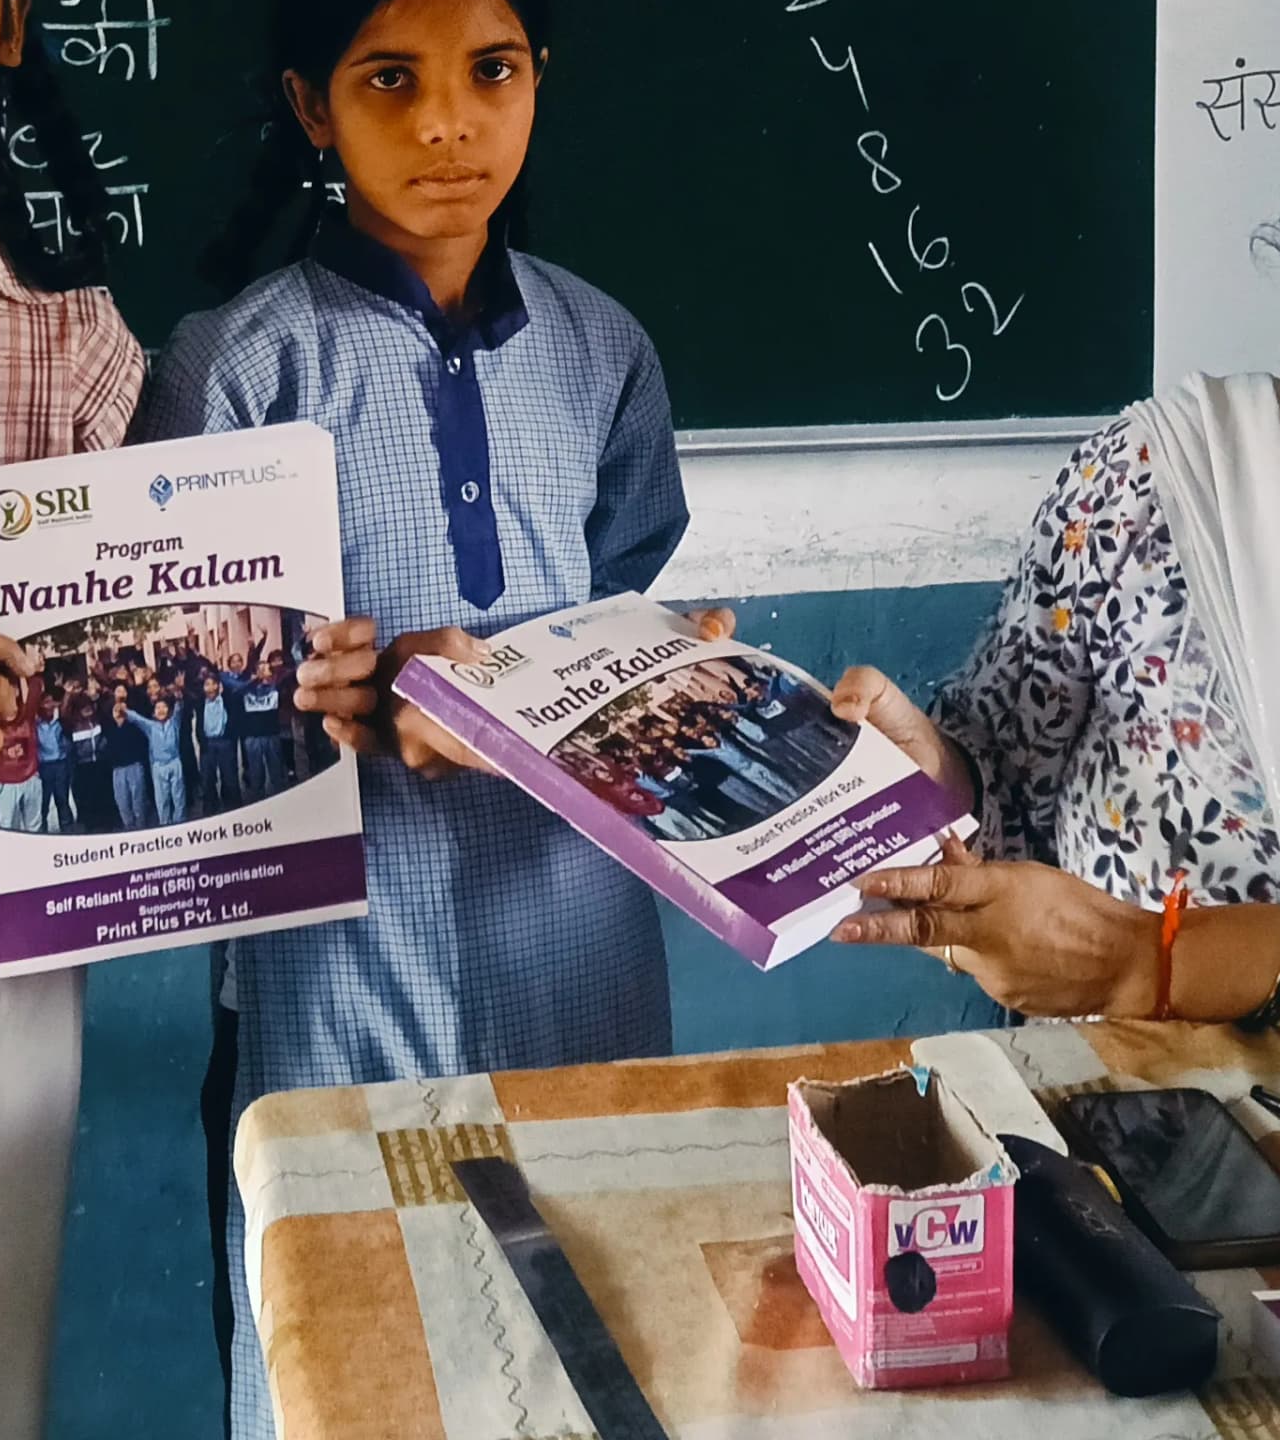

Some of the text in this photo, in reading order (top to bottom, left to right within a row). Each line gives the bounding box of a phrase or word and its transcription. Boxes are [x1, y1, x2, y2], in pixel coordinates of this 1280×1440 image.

[810, 35, 869, 112] 4
[857, 130, 902, 194] 8
[868, 203, 950, 295] 16
[915, 281, 1025, 401] 32
[34, 484, 93, 518] SRI
[176, 464, 279, 493] PRINTPLUS
[95, 536, 185, 562] Program
[145, 552, 286, 597] Kalam
[482, 644, 527, 674] SRI
[552, 646, 615, 681] Program
[514, 636, 698, 729] Nanhe Kalam
[52, 818, 274, 869] Student Practice Work Book
[45, 863, 285, 916] Self Reliant India (SRI) Organisation
[818, 864, 851, 889] Print
[843, 854, 874, 875] Plus
[96, 901, 254, 943] Print Plus Pvt. Ltd.
